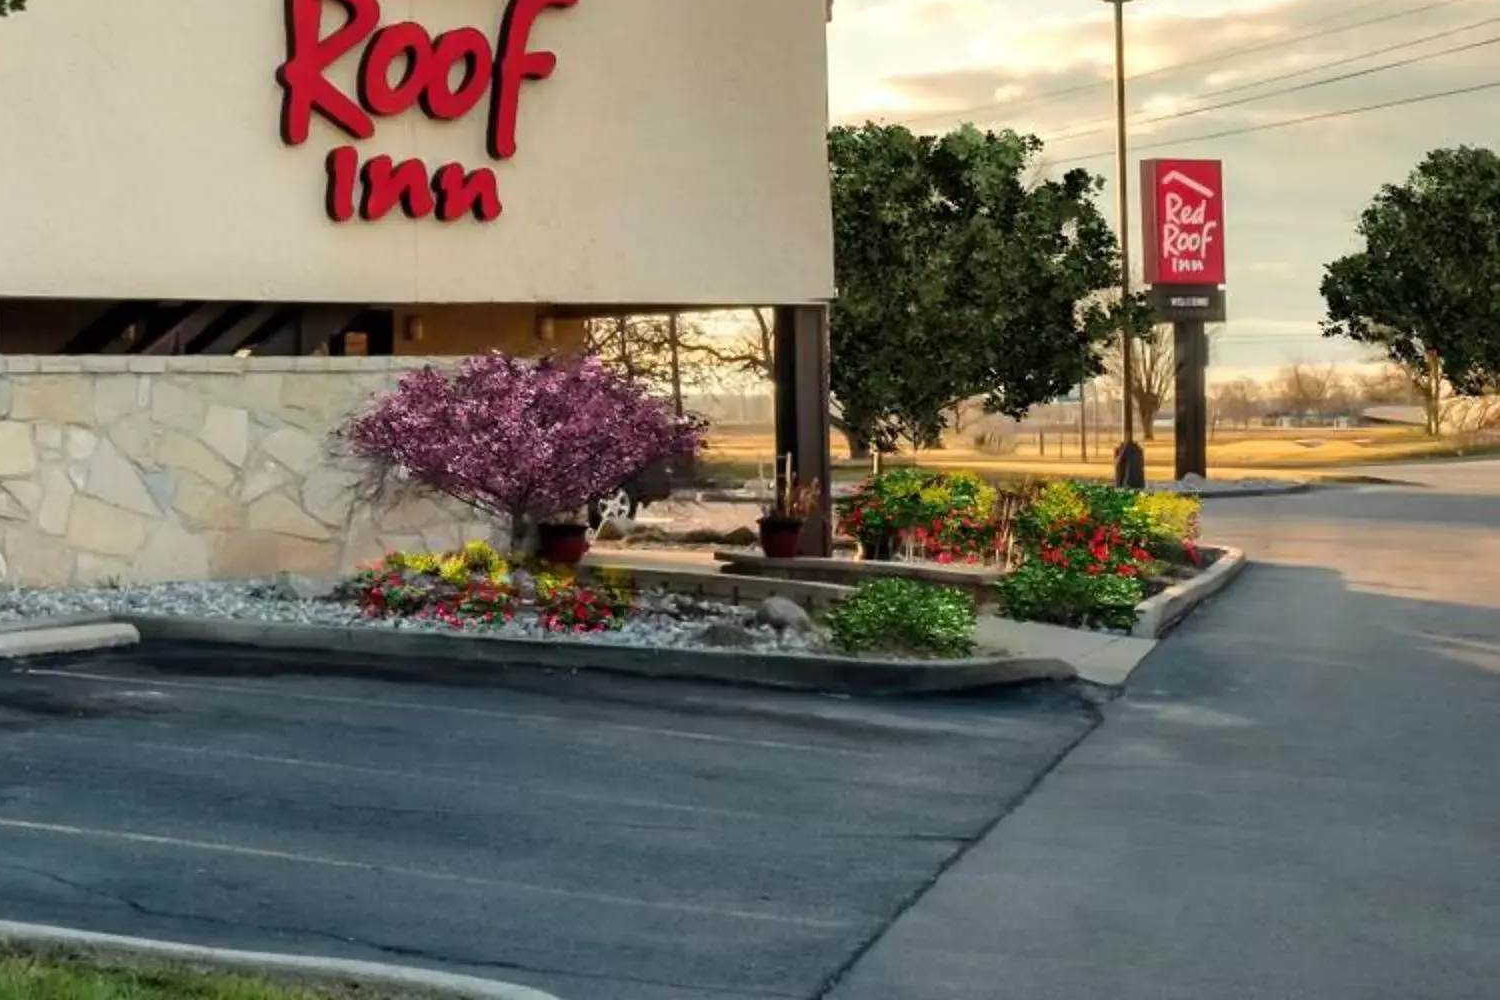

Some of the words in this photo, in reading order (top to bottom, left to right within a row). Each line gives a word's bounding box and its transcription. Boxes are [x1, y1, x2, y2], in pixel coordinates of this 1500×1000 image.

[325, 145, 503, 222] Inn
[1165, 192, 1206, 225] Red
[1163, 221, 1217, 259] Roof
